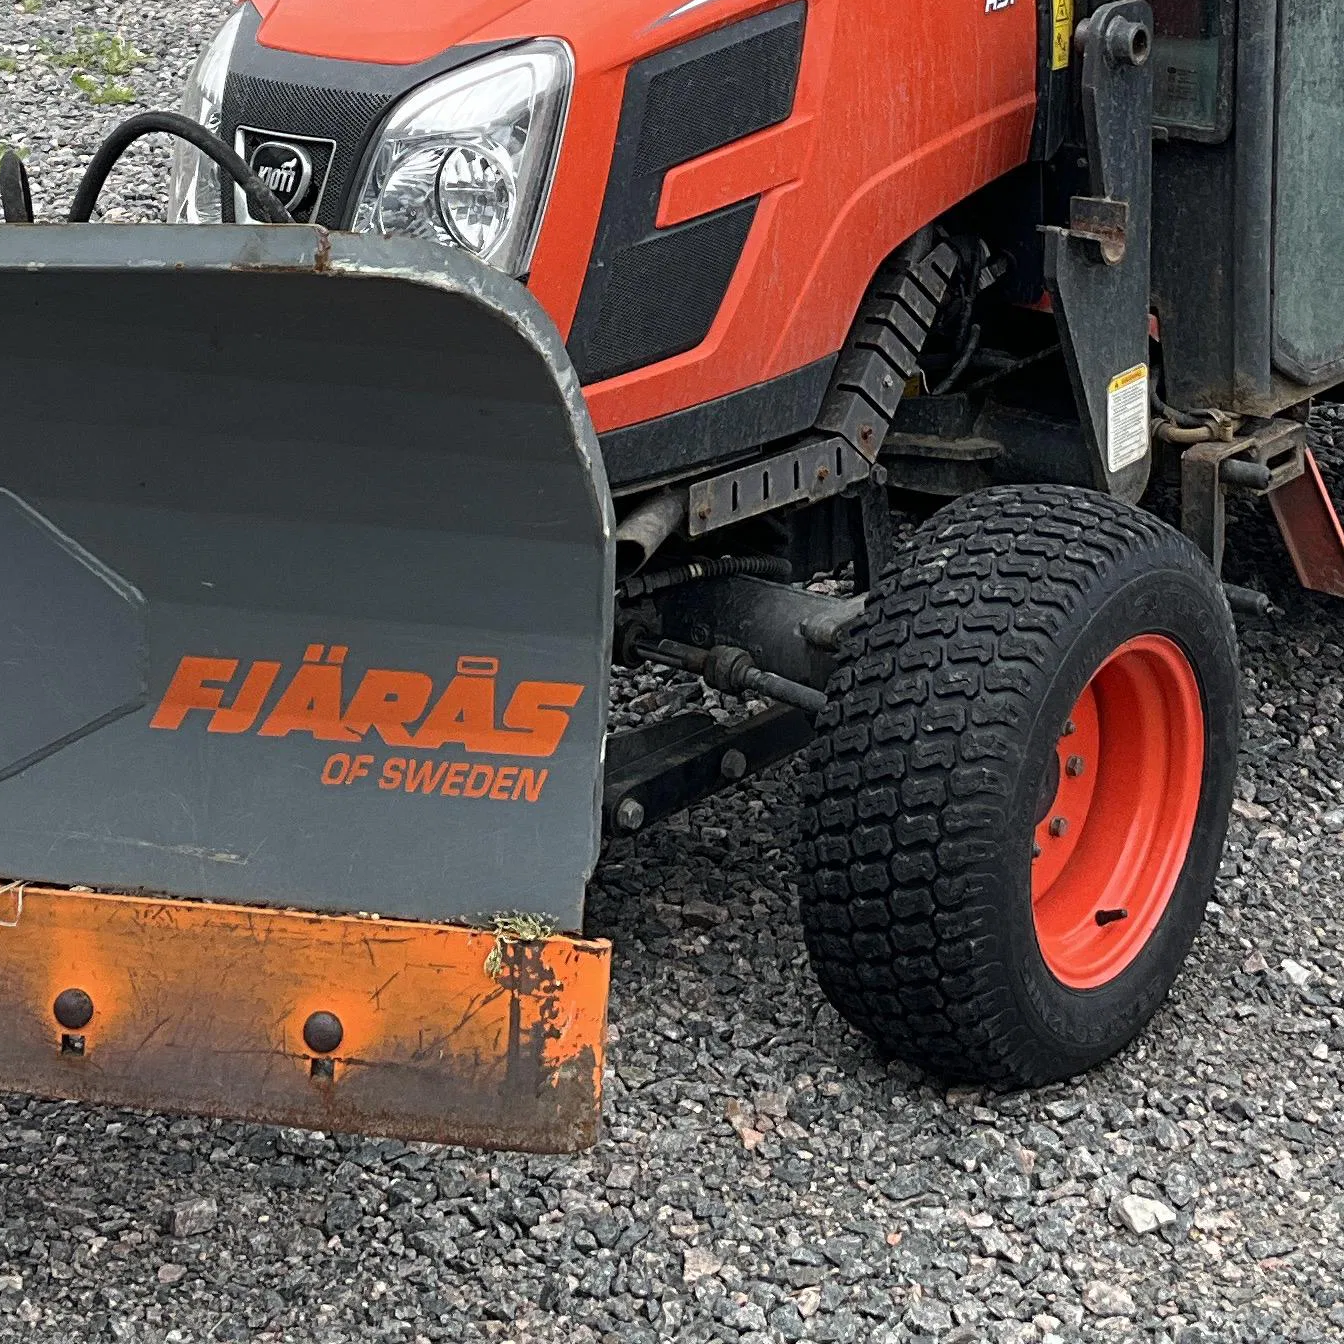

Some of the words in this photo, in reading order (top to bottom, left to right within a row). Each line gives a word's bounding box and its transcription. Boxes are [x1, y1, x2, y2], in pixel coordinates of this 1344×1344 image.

[149, 643, 585, 757] FJÄRÅS
[320, 752, 373, 787] OF
[377, 758, 550, 803] SWEDEN
